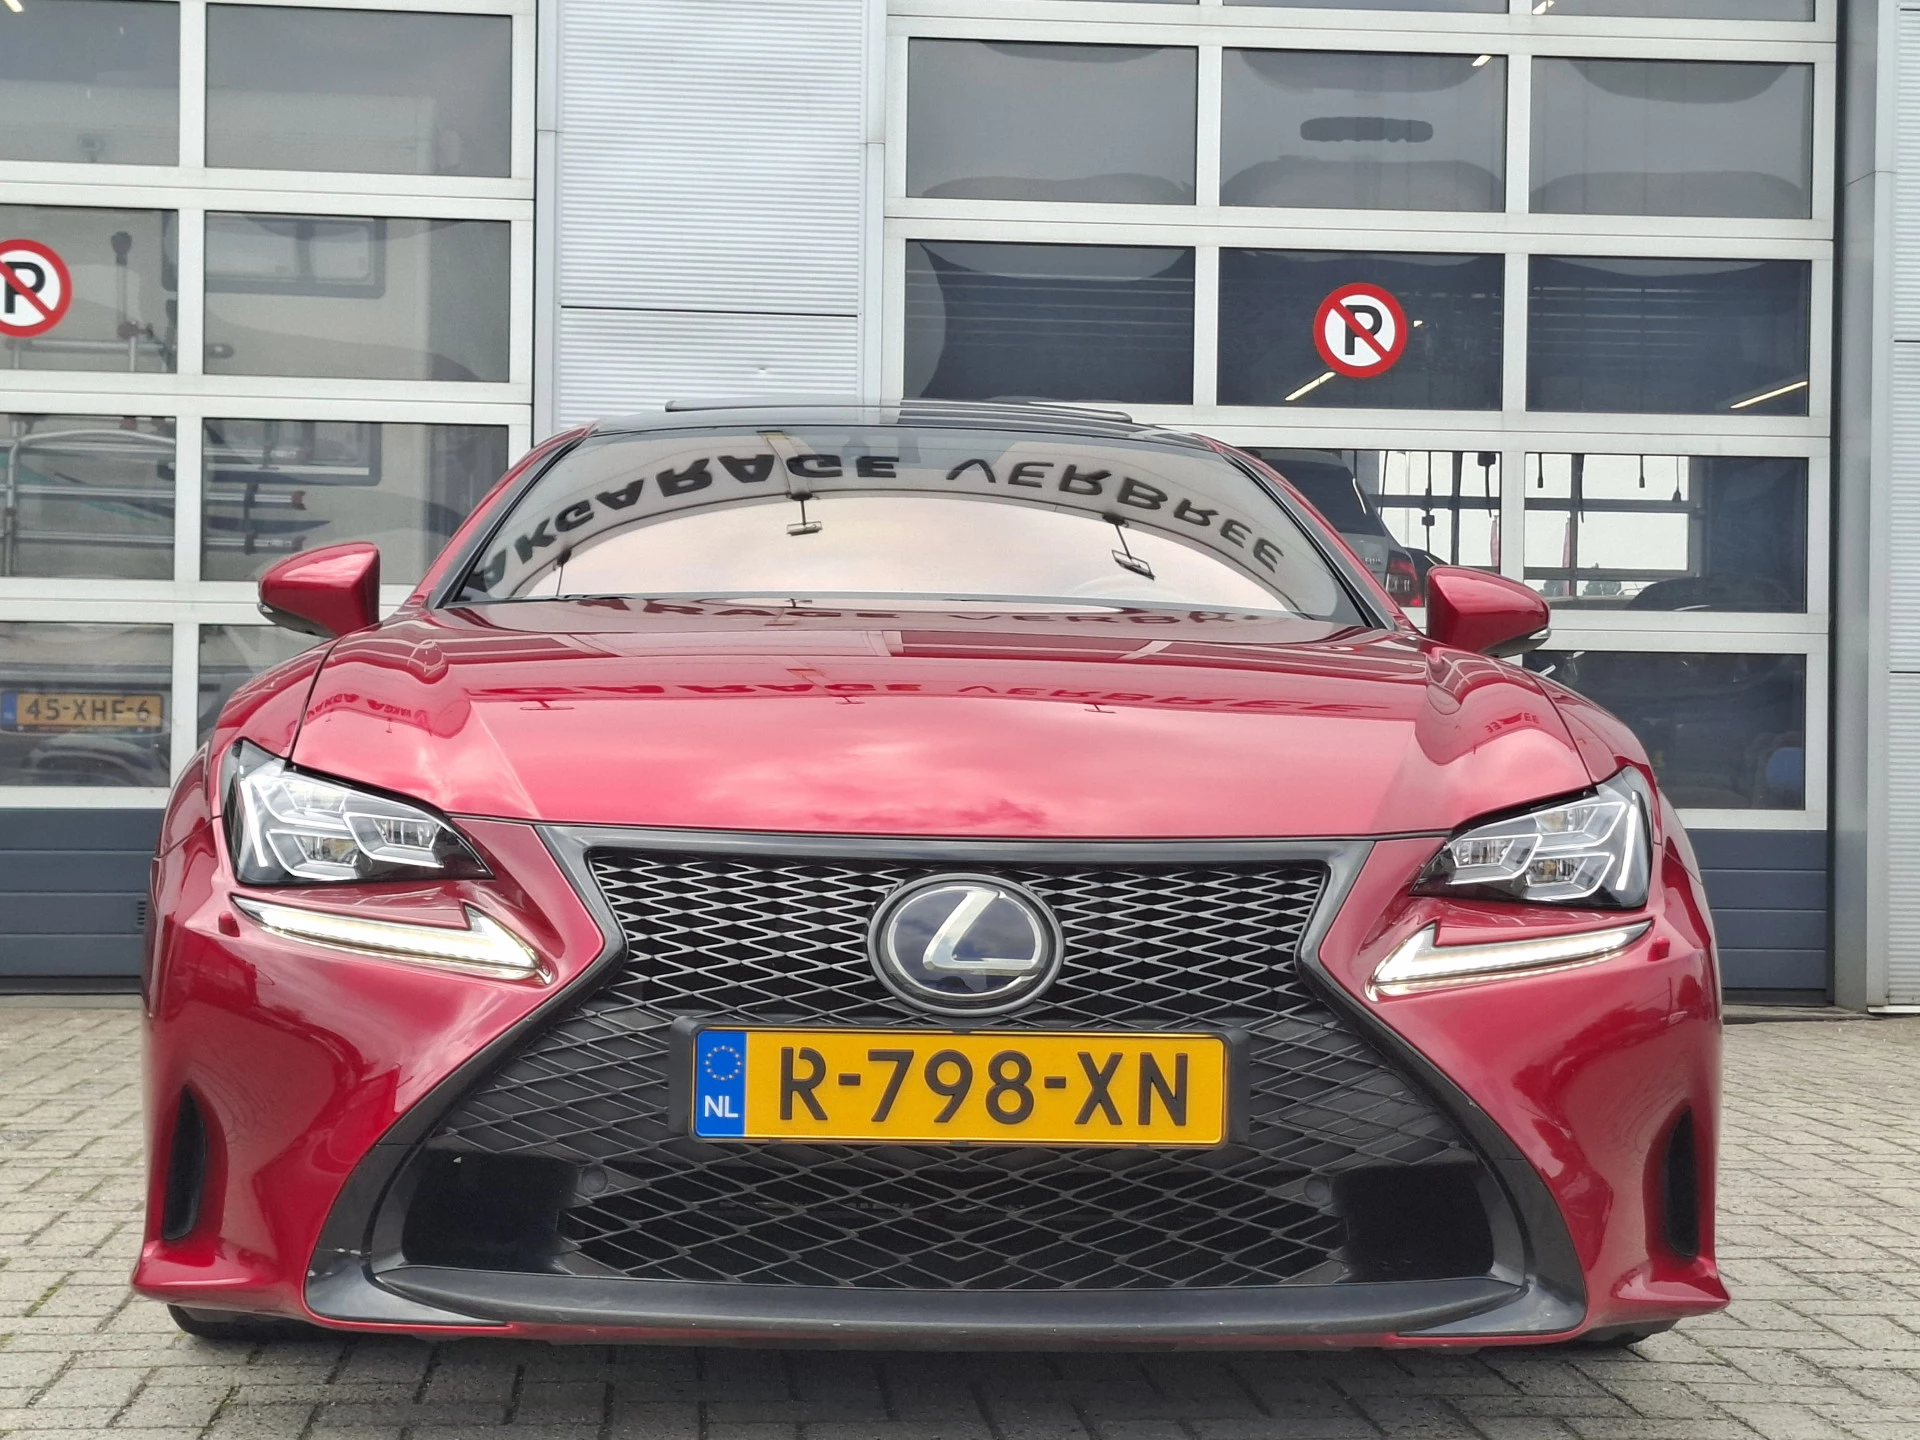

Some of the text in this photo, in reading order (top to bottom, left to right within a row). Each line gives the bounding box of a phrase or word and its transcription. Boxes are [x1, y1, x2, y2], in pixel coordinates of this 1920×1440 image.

[4, 261, 46, 314] P
[1344, 304, 1383, 356] P
[26, 698, 152, 722] 45-XHF-6
[703, 1094, 739, 1118] NL
[779, 1046, 1187, 1126] R-798-XN
